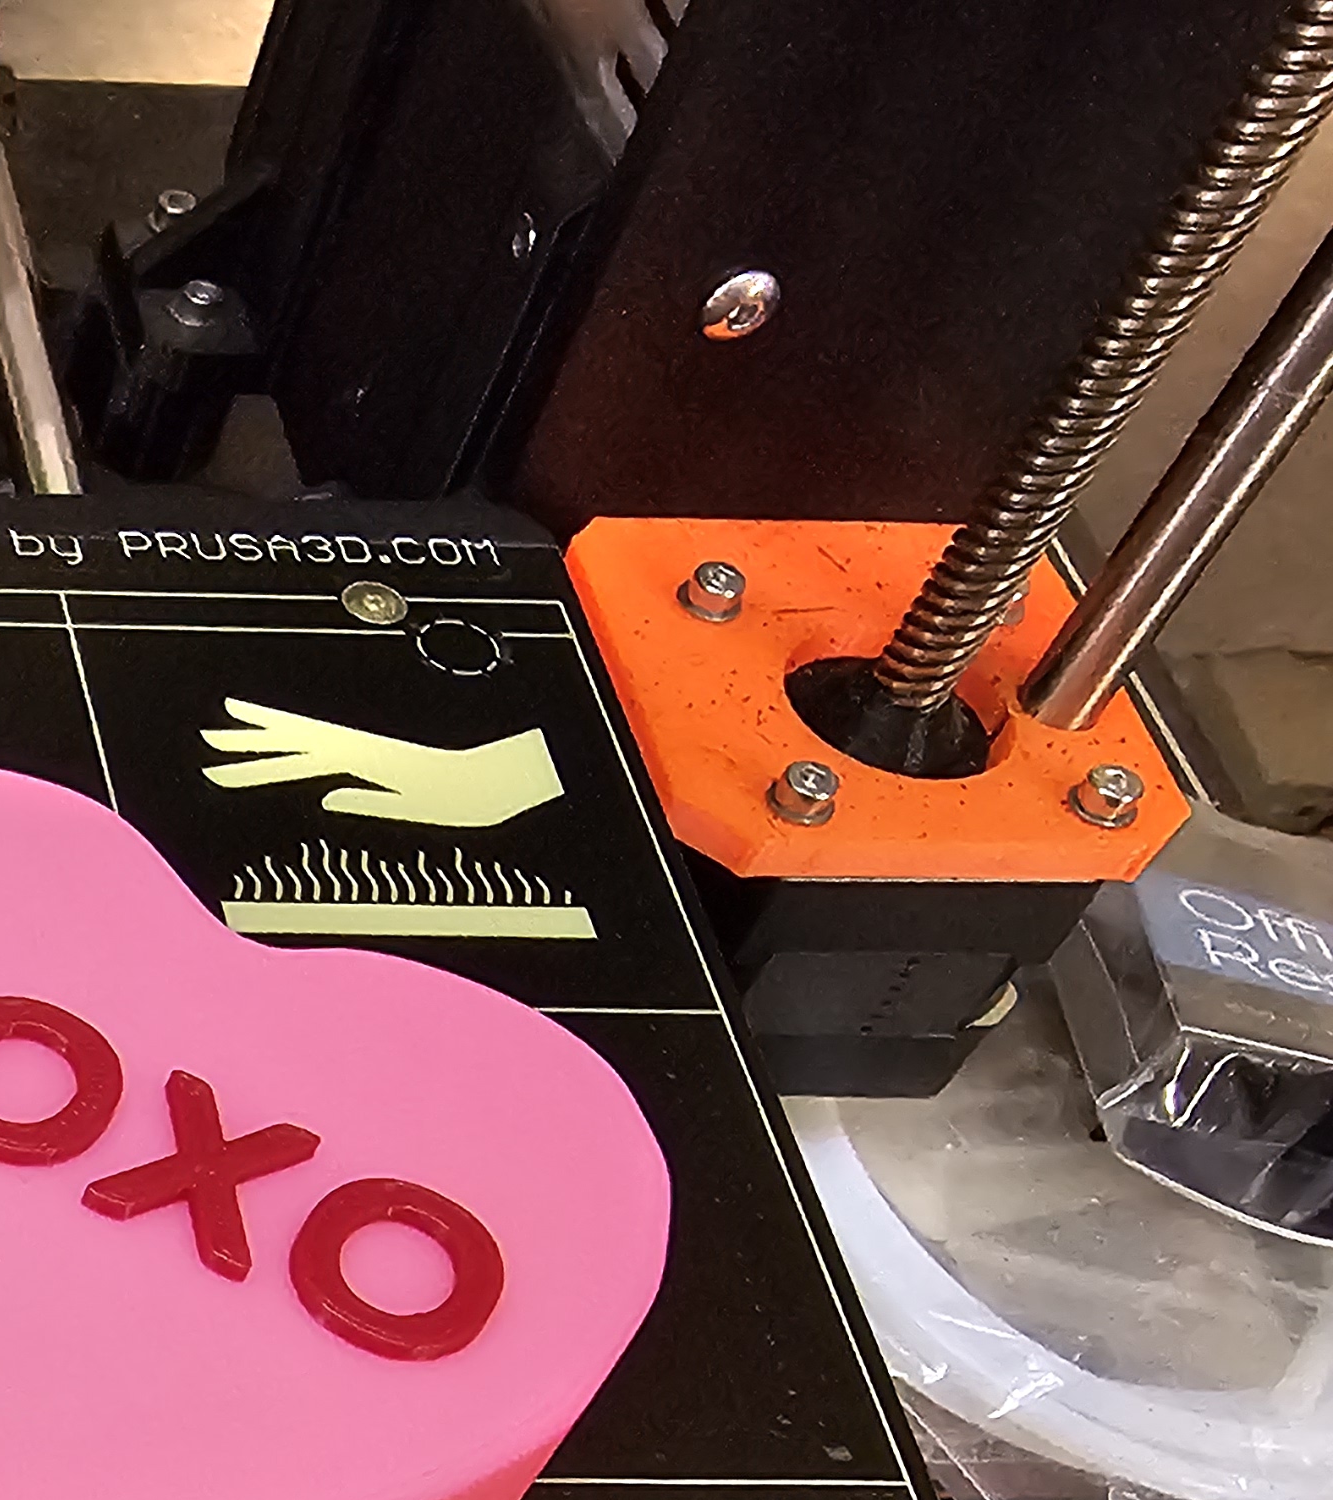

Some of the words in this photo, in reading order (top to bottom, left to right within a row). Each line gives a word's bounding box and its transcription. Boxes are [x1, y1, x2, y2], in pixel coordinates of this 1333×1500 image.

[7, 525, 84, 566] by
[116, 528, 502, 568] PRUSA3D.COM
[1195, 927, 1333, 998] Re
